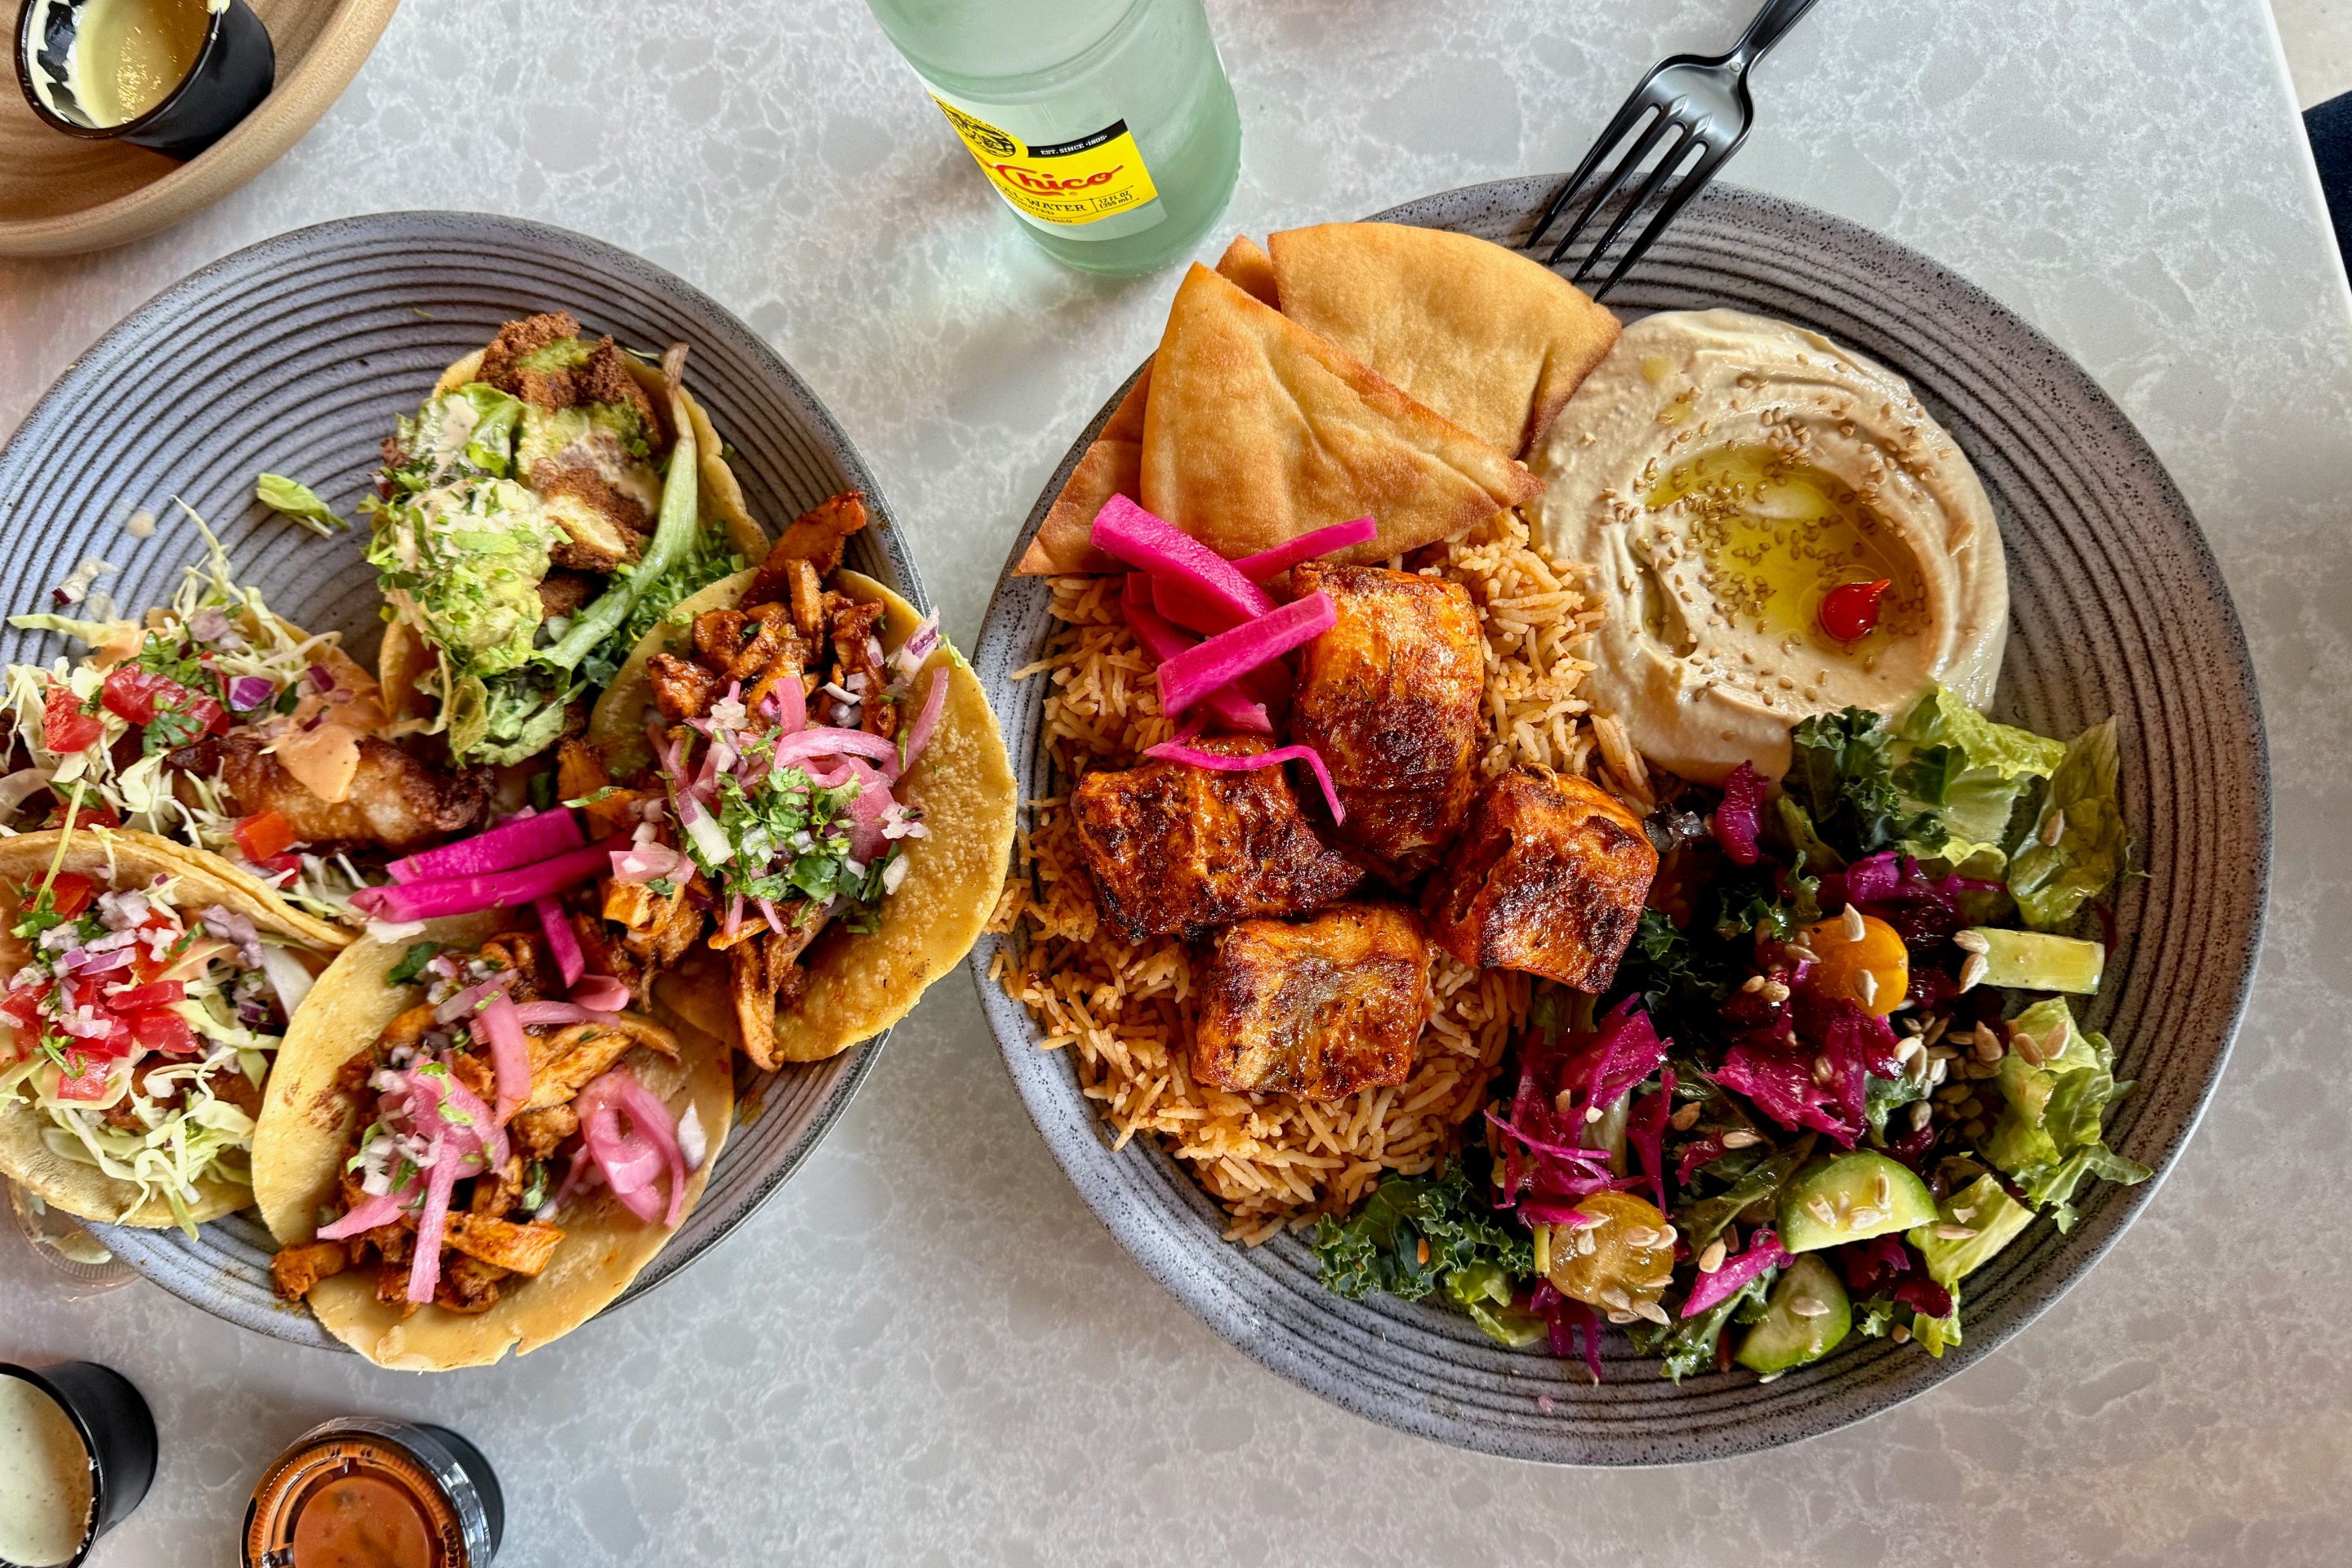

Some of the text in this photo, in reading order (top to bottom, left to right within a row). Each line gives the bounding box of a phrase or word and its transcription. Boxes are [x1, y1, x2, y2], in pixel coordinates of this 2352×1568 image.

[1059, 143, 1085, 154] SINCE
[996, 164, 1124, 197] Chico
[1120, 190, 1129, 198] OZ
[1024, 197, 1087, 212] WATER
[1099, 200, 1118, 209] (355
